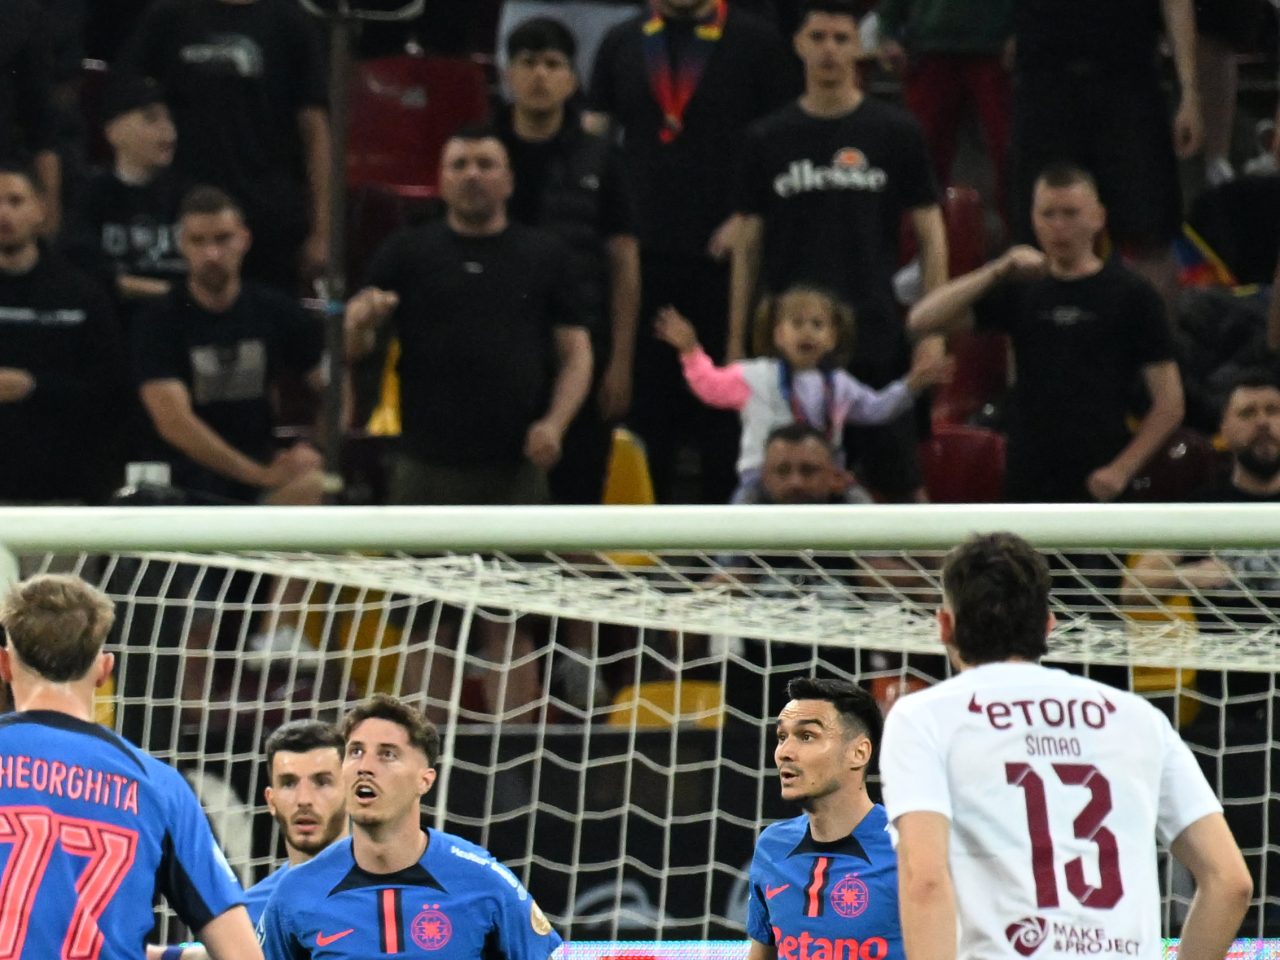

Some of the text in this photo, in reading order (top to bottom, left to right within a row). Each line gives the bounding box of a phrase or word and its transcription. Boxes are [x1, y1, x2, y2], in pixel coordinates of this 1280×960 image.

[774, 159, 887, 197] ellesse
[1004, 761, 1124, 910] 13
[1053, 922, 1106, 940] MAKE
[1053, 938, 1140, 956] &PROJECT
